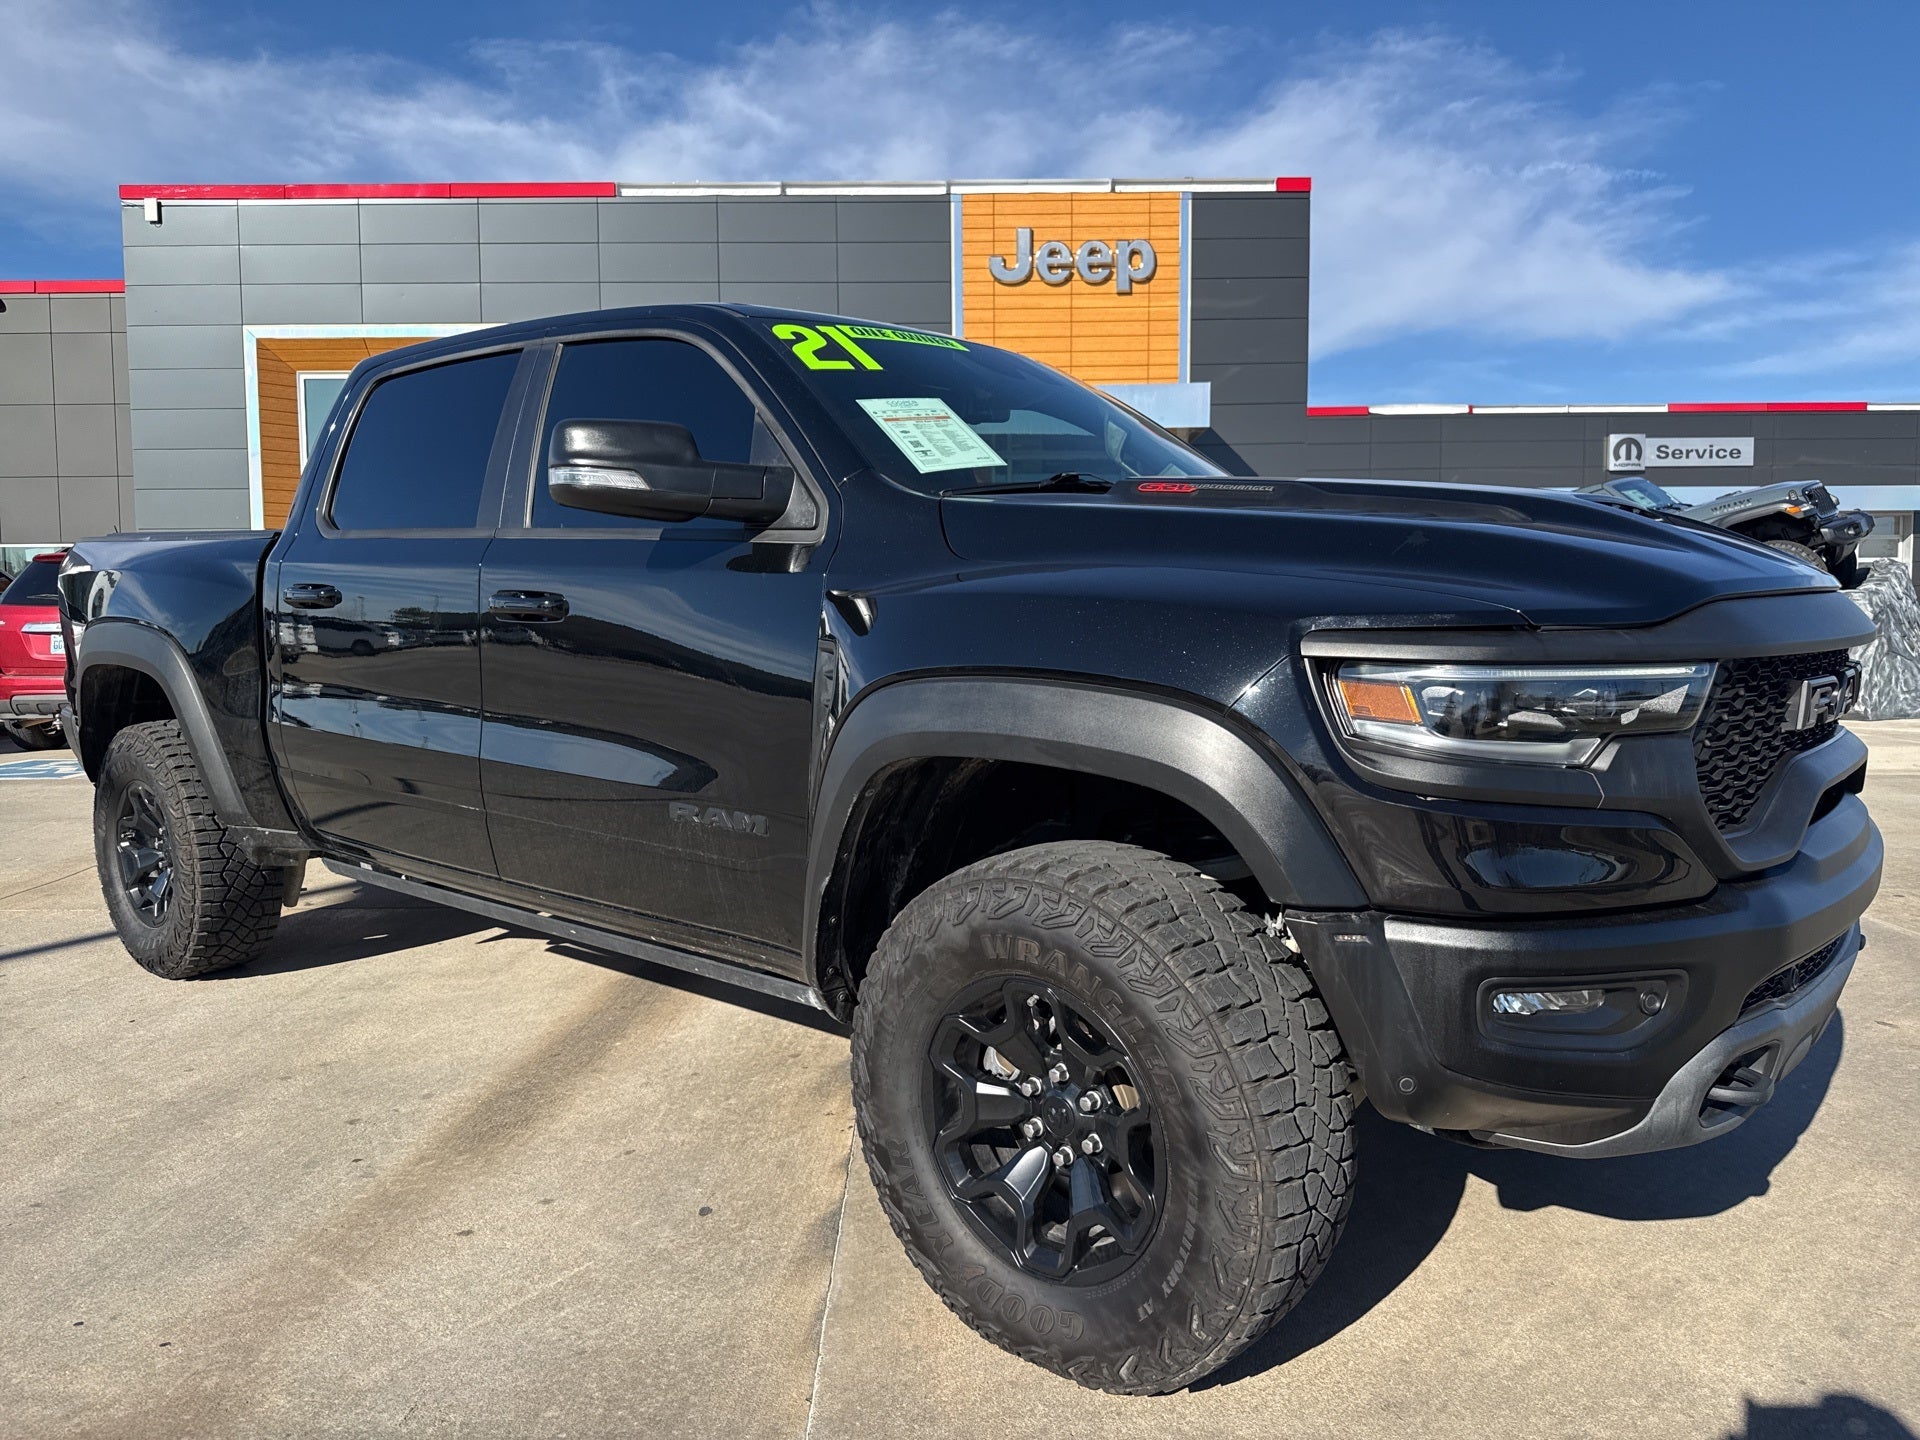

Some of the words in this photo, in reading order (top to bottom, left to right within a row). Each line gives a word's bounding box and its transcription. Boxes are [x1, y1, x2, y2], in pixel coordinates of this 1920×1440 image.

[989, 227, 1157, 295] Jeep
[772, 324, 883, 370] 21
[849, 327, 892, 338] ONE
[1656, 444, 1741, 459] Service
[1796, 660, 1862, 730] RA
[668, 801, 769, 837] RAM
[980, 934, 1182, 1105] WRANGLER
